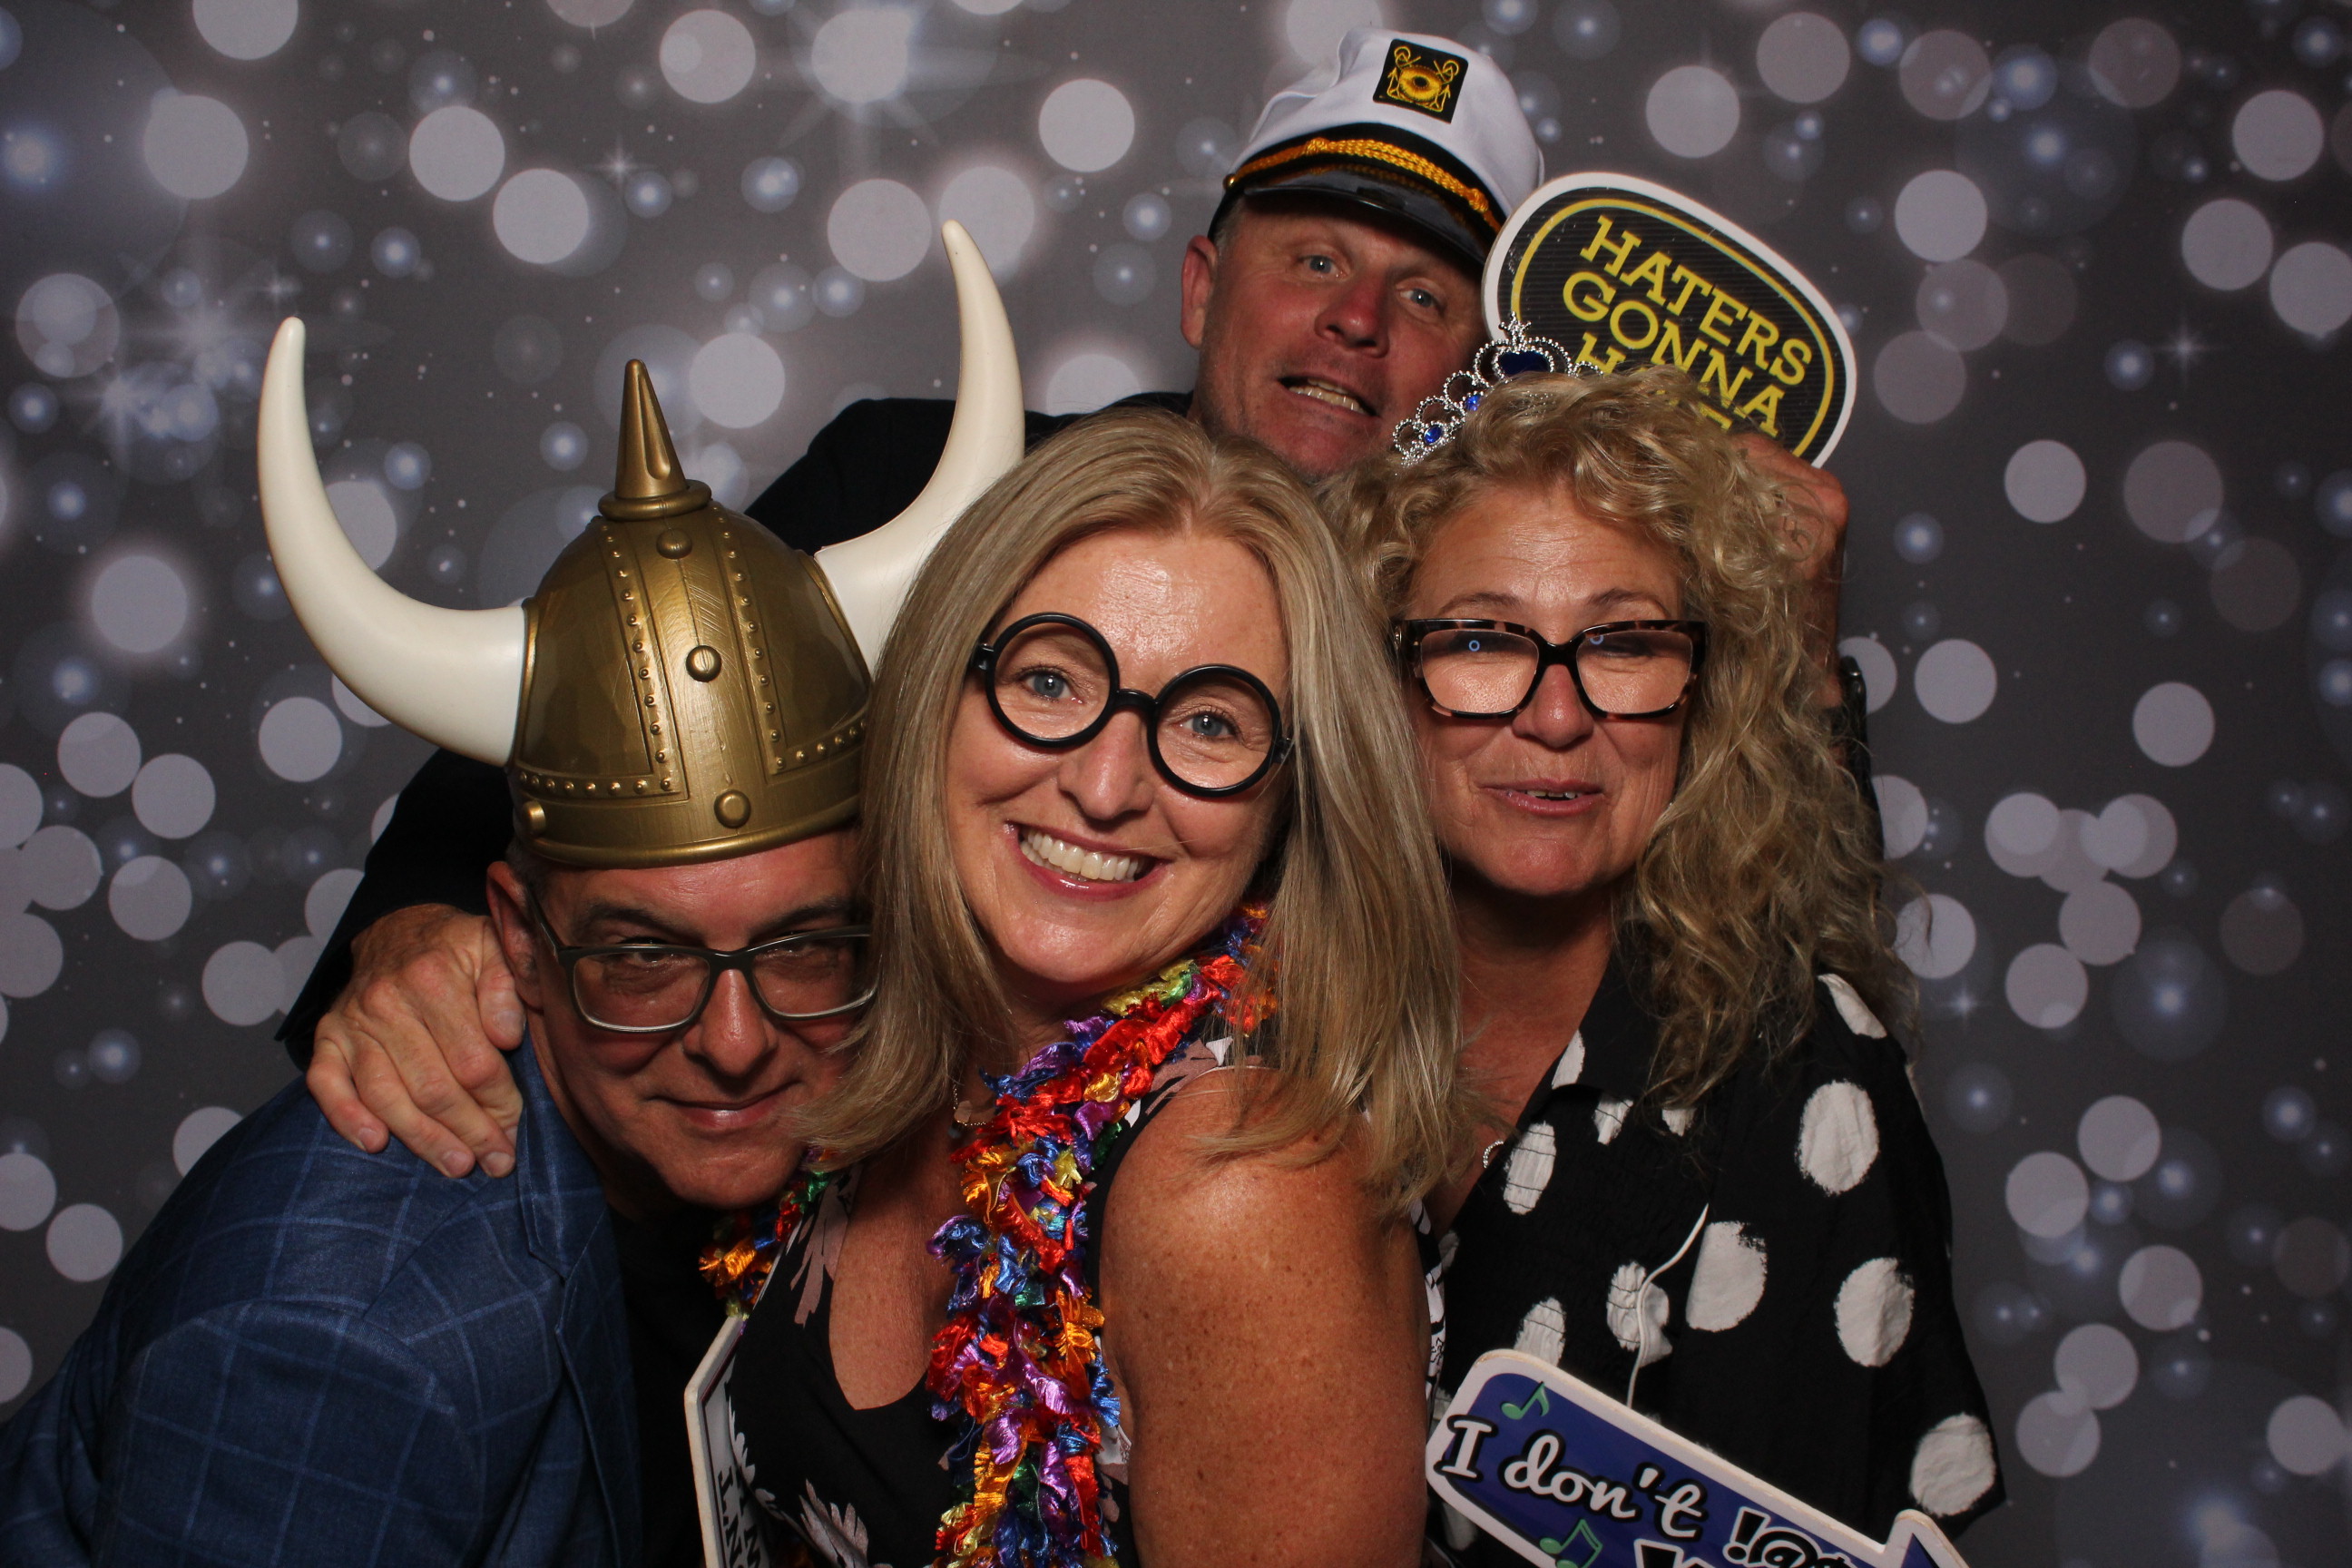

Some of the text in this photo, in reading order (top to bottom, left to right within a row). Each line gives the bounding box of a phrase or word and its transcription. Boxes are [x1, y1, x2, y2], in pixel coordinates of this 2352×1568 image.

[1563, 271, 1786, 438] GONNA
[1579, 215, 1813, 386] HATERS
[1438, 1418, 1494, 1481] I
[1502, 1432, 1705, 1540] don't
